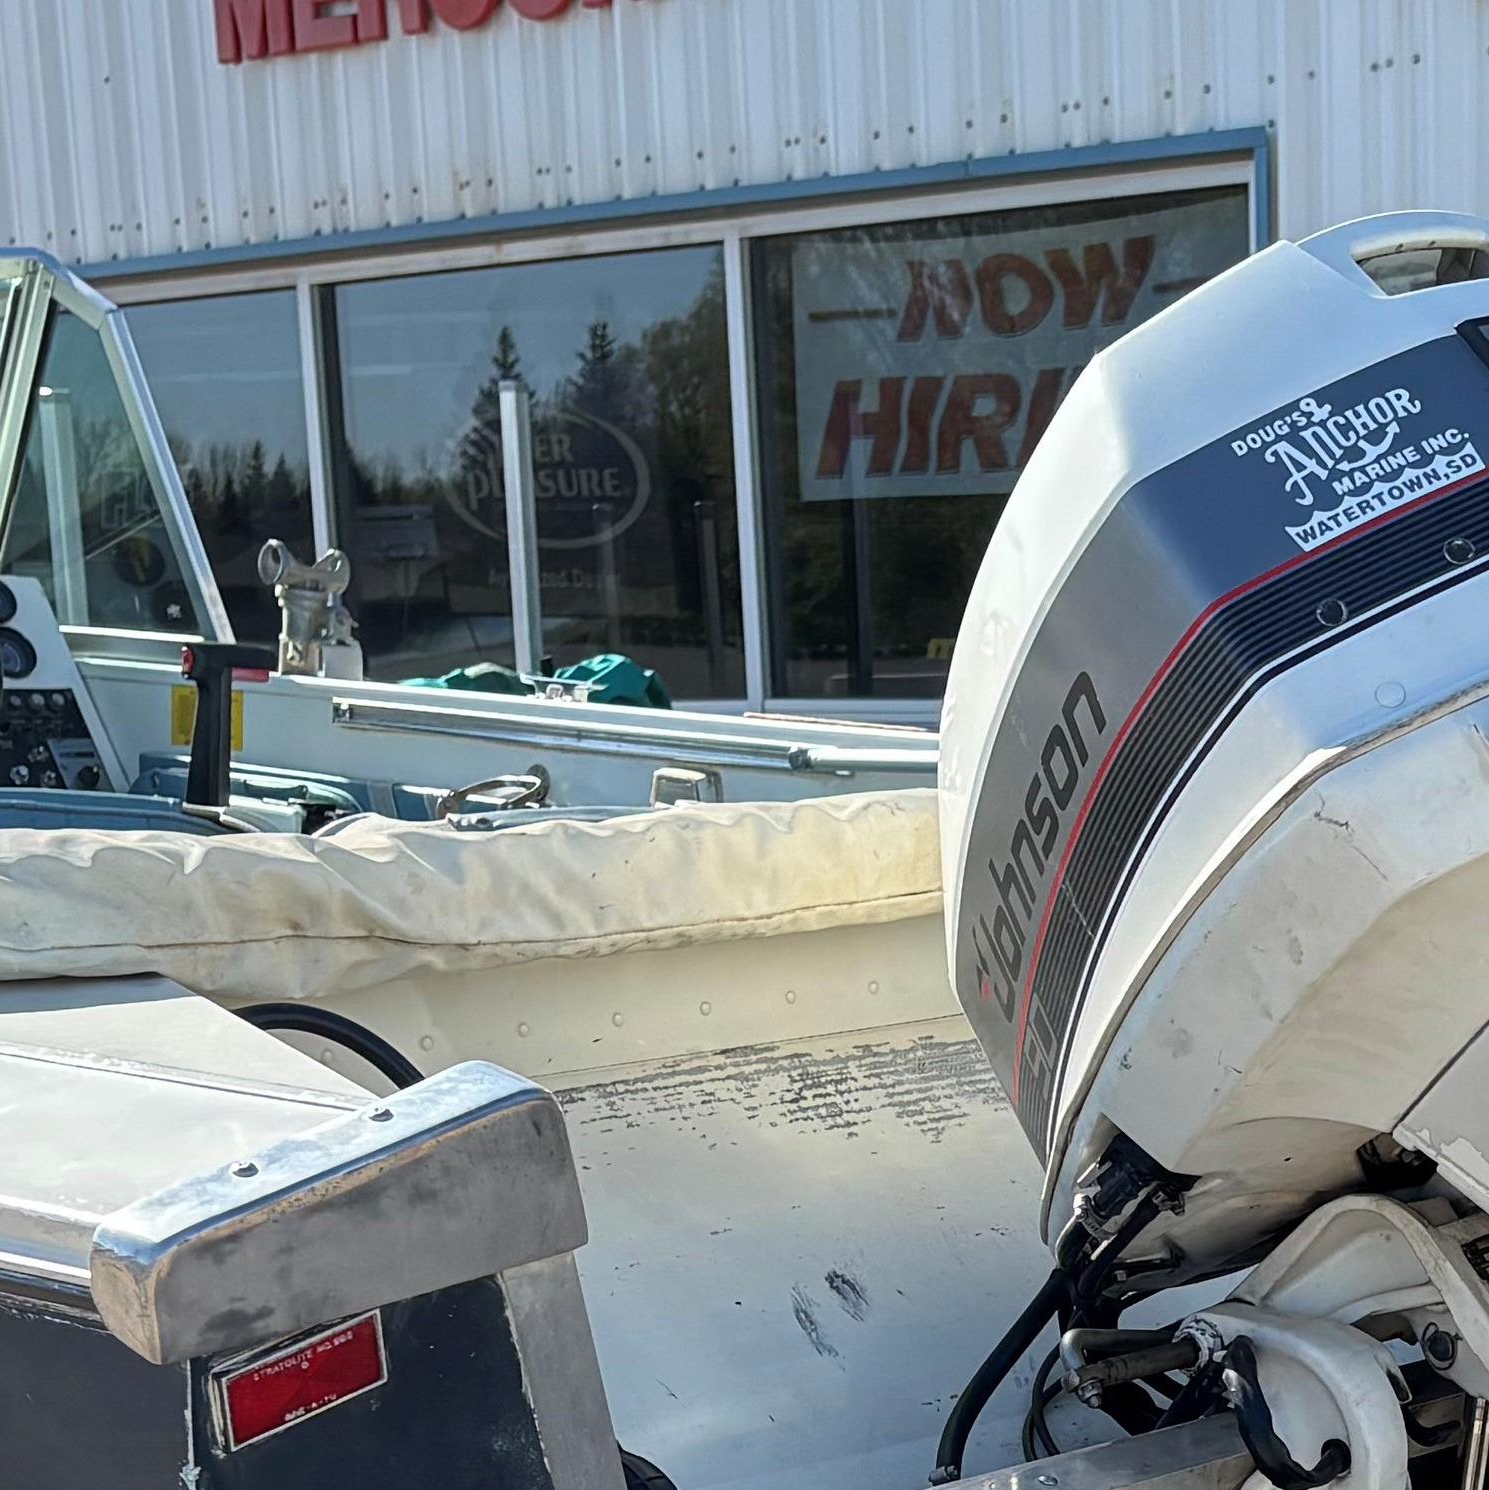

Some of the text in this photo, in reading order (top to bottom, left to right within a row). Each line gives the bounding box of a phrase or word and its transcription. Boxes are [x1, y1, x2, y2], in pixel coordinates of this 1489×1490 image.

[897, 235, 1155, 343] NOW
[816, 367, 1076, 479] HIRI
[1230, 412, 1308, 457] DOUG'S
[1264, 388, 1421, 505] ANCHOR
[1332, 428, 1470, 495] MARINE INC.
[979, 671, 1107, 1024] Johnson
